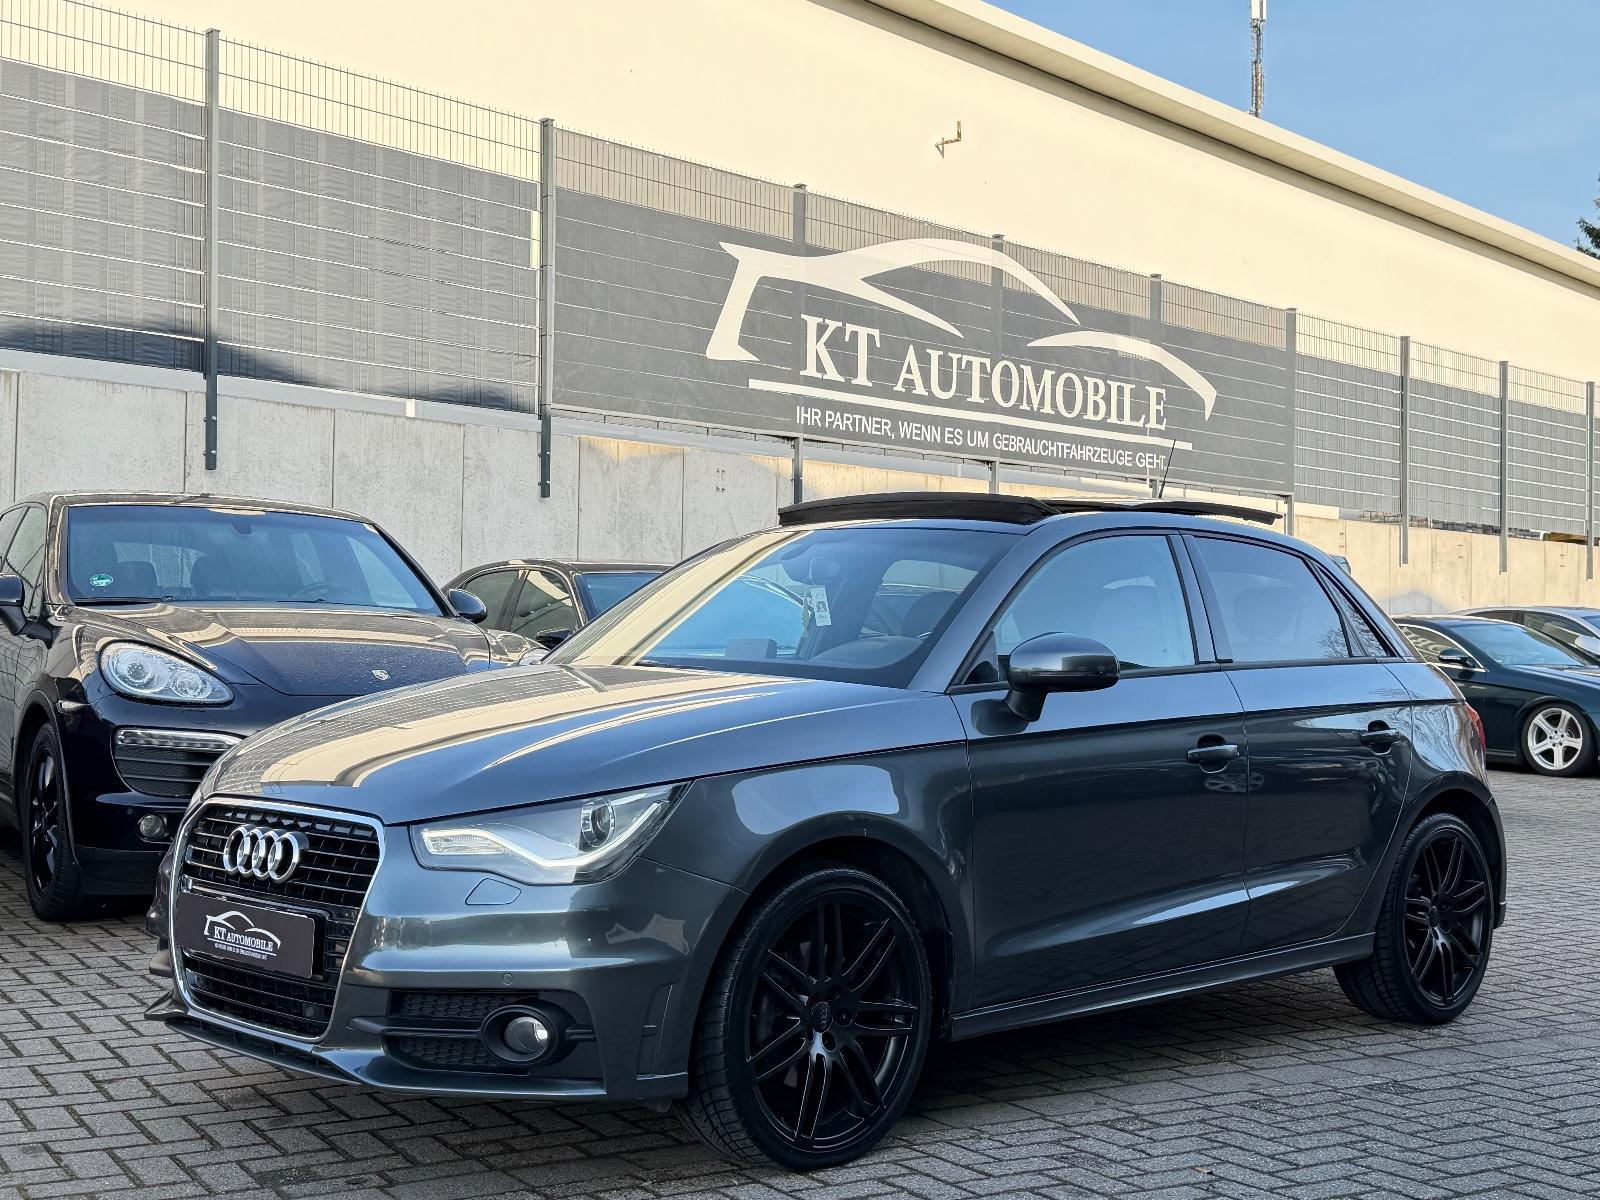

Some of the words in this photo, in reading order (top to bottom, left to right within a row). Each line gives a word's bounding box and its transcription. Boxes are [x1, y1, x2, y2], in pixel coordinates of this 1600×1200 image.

[800, 313, 880, 387] KT
[893, 344, 1167, 431] AUTOMOBILE
[796, 405, 822, 427] IHR
[825, 410, 895, 440] PARTNER,
[899, 421, 941, 443] WENN
[944, 427, 963, 446] ES
[967, 430, 989, 449] UM
[992, 432, 1132, 467] GEBRAUCHTFAHRZEUGE
[214, 926, 226, 940] KT
[226, 932, 273, 951] AUTOMOBILE
